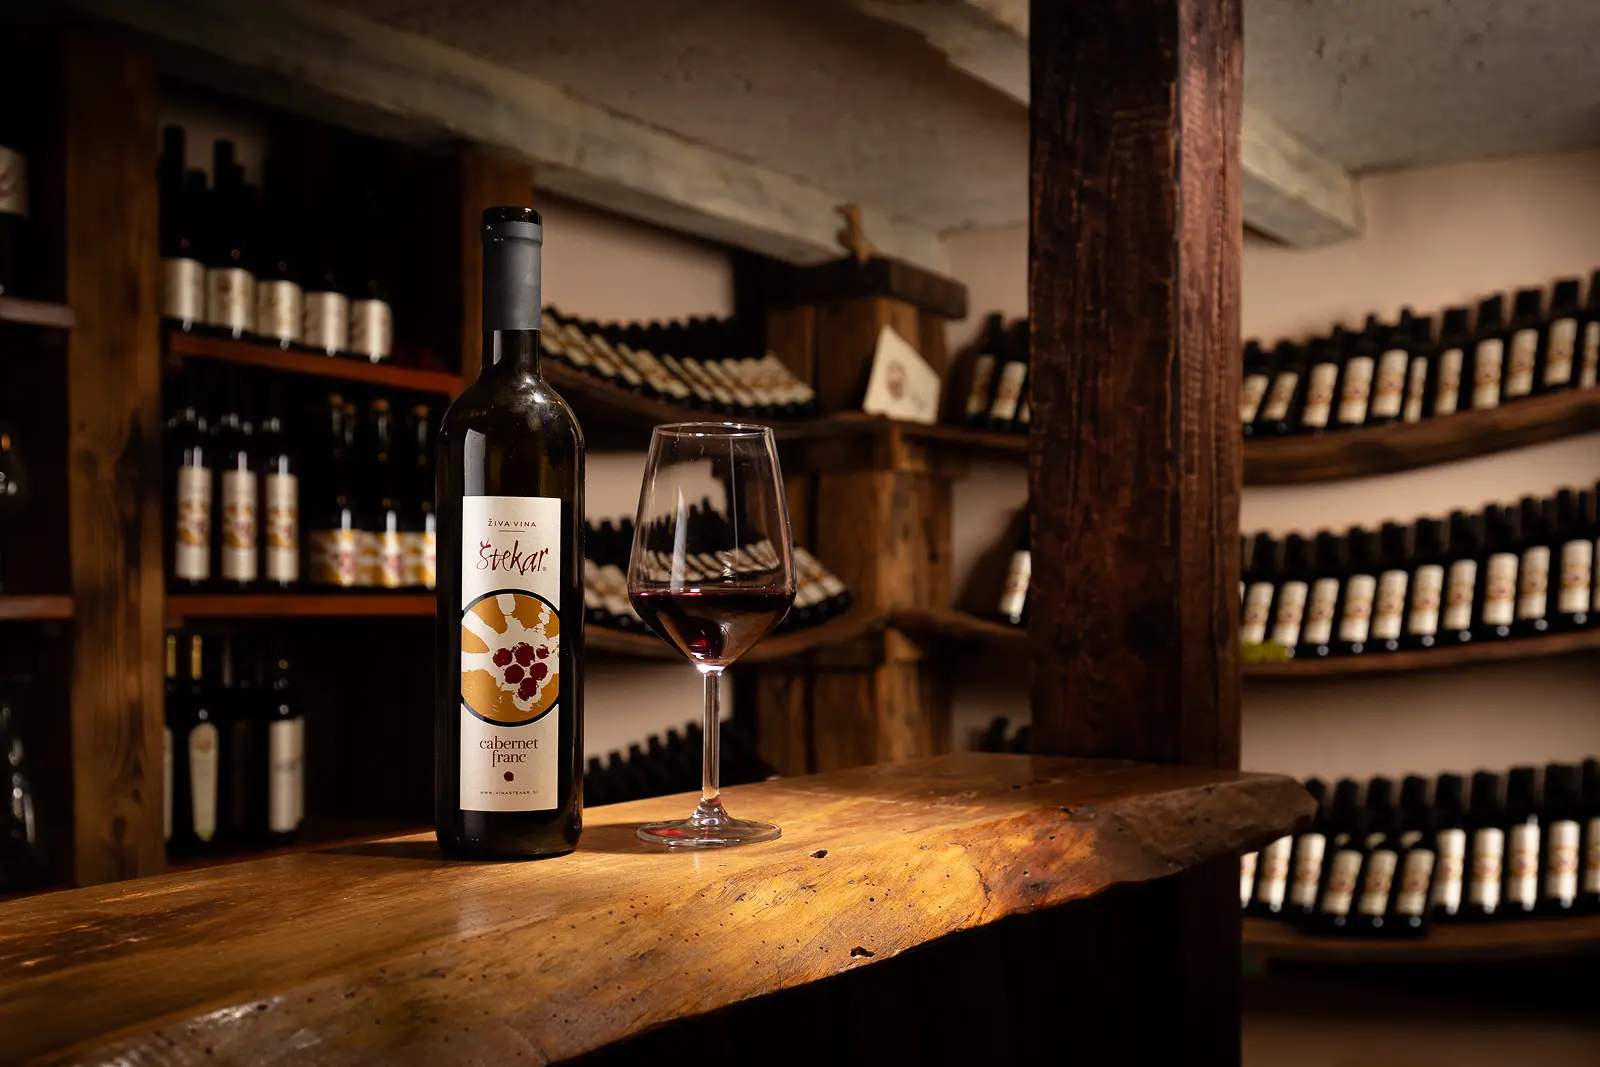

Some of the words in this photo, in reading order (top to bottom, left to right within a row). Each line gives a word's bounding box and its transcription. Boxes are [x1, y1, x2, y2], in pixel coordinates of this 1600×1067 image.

[487, 518, 510, 527] ŽIVA
[476, 538, 549, 576] Štekar
[479, 735, 539, 750] cabernet
[491, 749, 527, 767] franc
